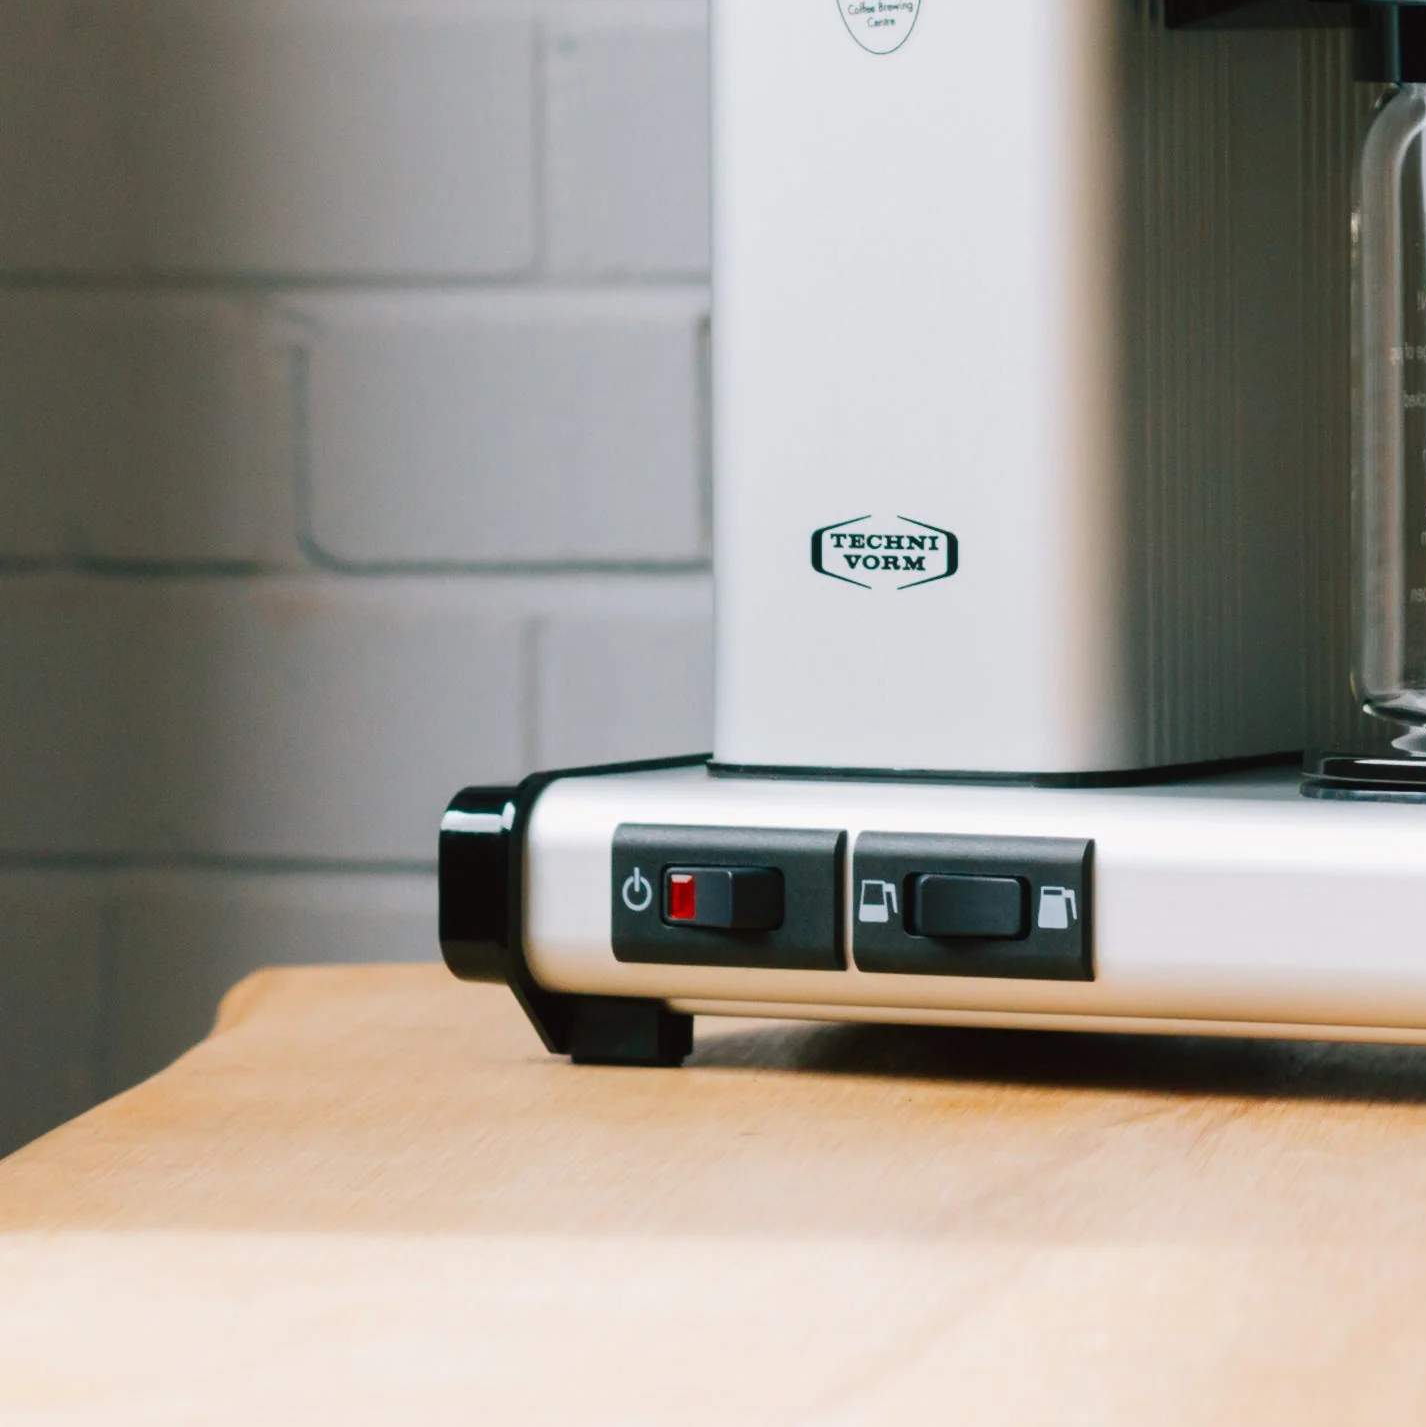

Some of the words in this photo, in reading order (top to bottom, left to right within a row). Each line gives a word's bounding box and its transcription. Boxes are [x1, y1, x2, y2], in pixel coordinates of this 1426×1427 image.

[847, 2, 876, 15] Coffee
[878, 1, 913, 13] Brewing
[867, 17, 896, 28] Centre
[830, 532, 939, 551] TECHNI
[843, 554, 927, 572] VORM
